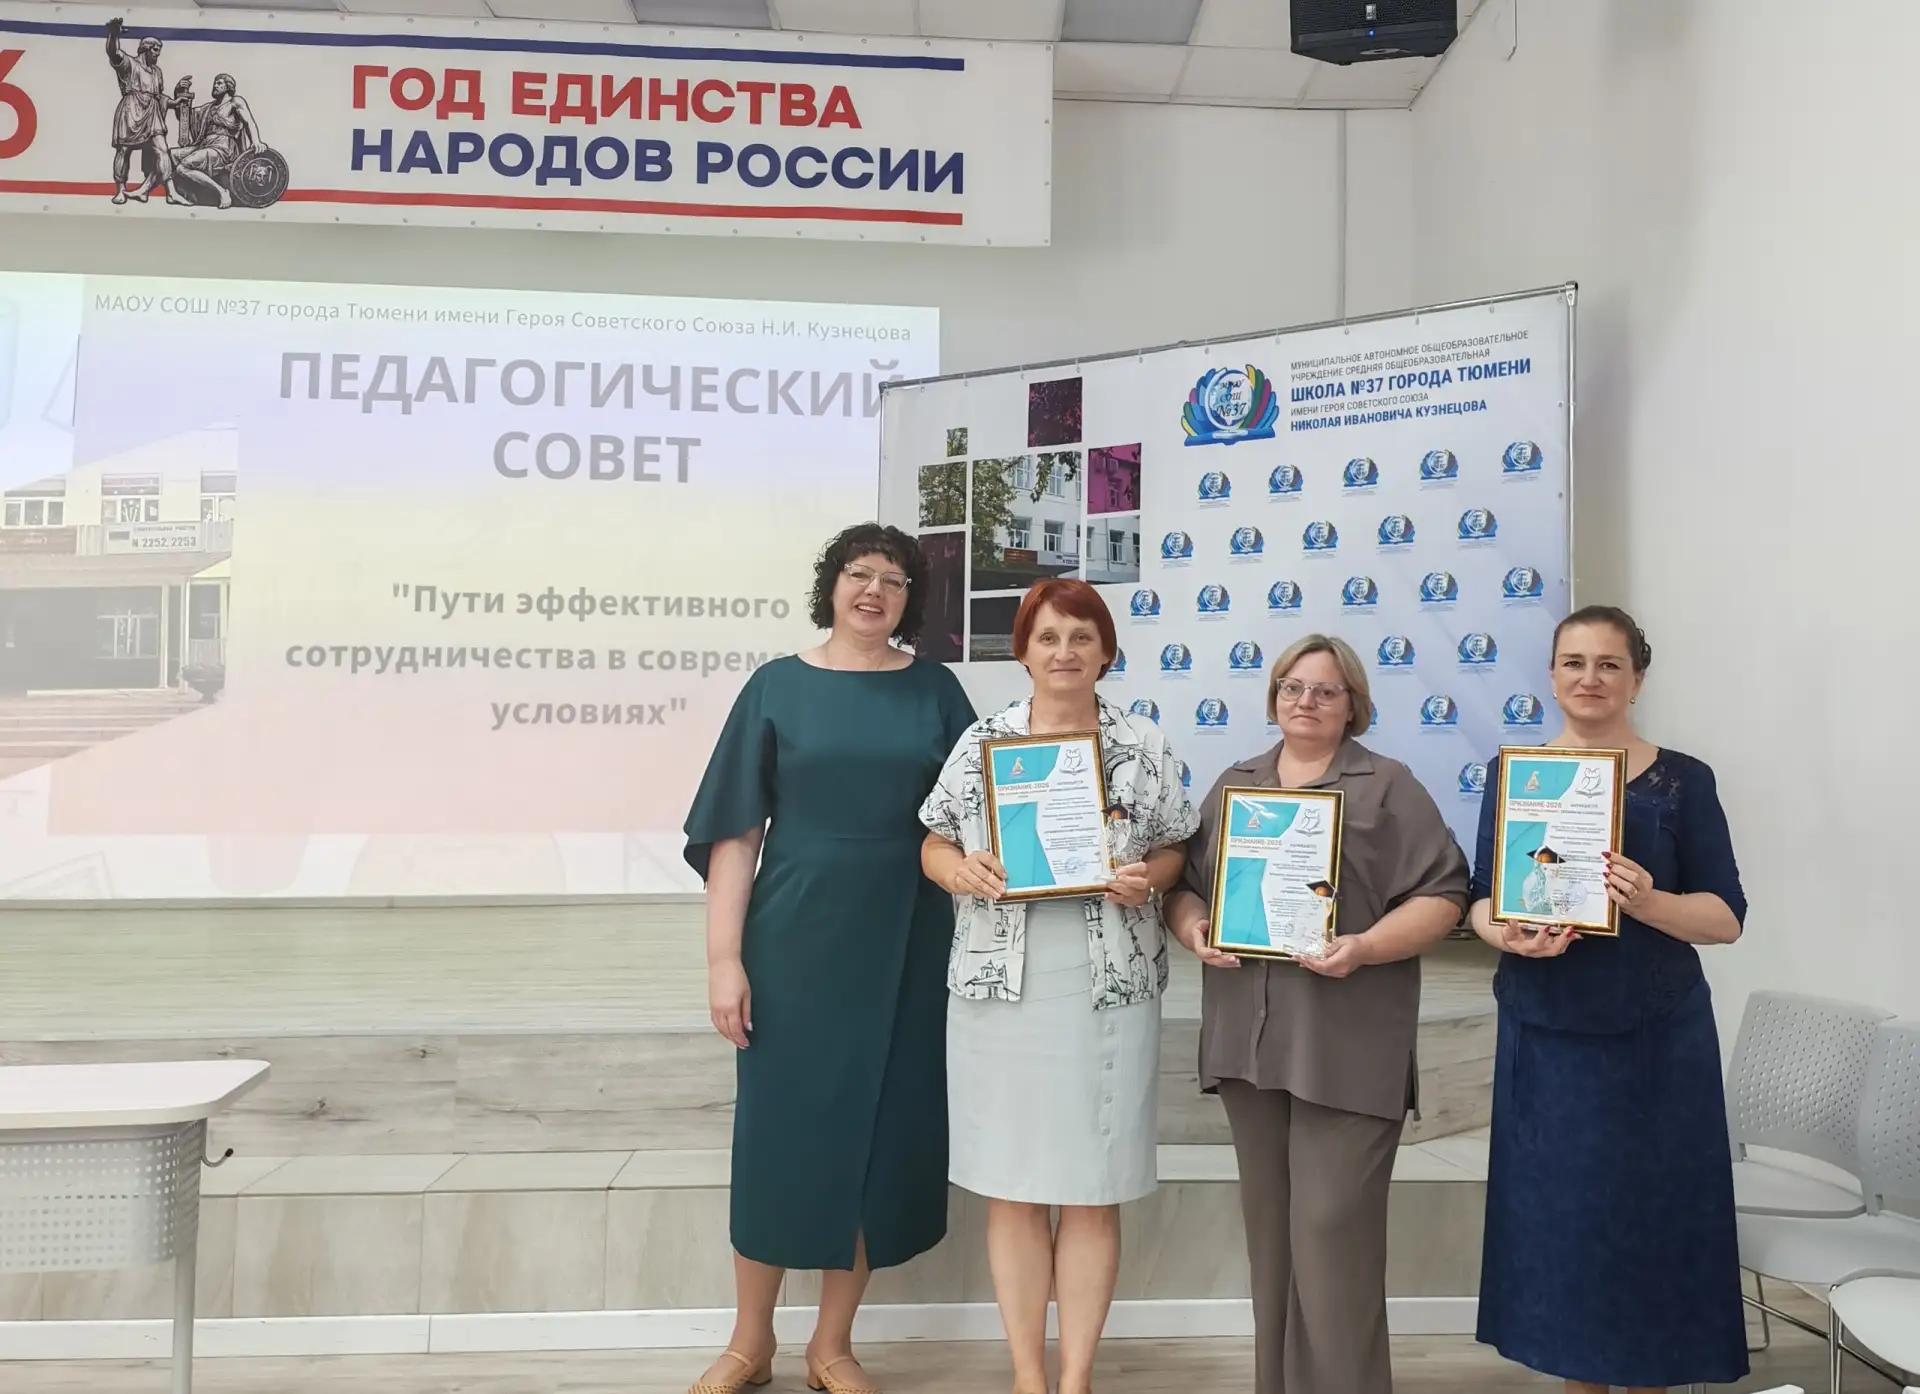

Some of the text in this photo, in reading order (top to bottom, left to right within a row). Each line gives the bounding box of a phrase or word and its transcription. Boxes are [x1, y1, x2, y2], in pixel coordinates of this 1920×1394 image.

[353, 65, 863, 129] ГОД ЕДИНСТВА
[350, 128, 964, 195] НАРОДОВ РОССИИ
[95, 294, 912, 342] МАОУ СОШ №37 города Тюмени имени Героя Советского Союза Н.И. Кузнецова
[1291, 330, 1529, 370] МУНИЦИПАЛЬНОЕ АВТОНОМНОЕ ОБЩЕОБРАЗОВАТЕЛЬНОЕ
[1291, 348, 1490, 382] УЧРЕЖДЕНИЕ СРЕДНЯЯ ОБЩЕОБРАЗОВАТЕЛЬНАЯ
[1291, 358, 1531, 402] ШКОЛА №37 ГОРОДА ТЮМЕНИ
[1216, 402, 1247, 418] №37
[1290, 399, 1488, 432] НИКОЛАЯ ИВАНОВИЧА КУЗНЕЦОВА
[1291, 392, 1429, 417] ИМЕНИ ГЕРОЯ СОВЕТСКОГО СОЮЗА
[493, 430, 702, 484] СОВЕТ
[391, 582, 791, 622] "Пути эффективного
[285, 642, 787, 678] сотрудничества в соврем
[491, 697, 688, 731] условиях"
